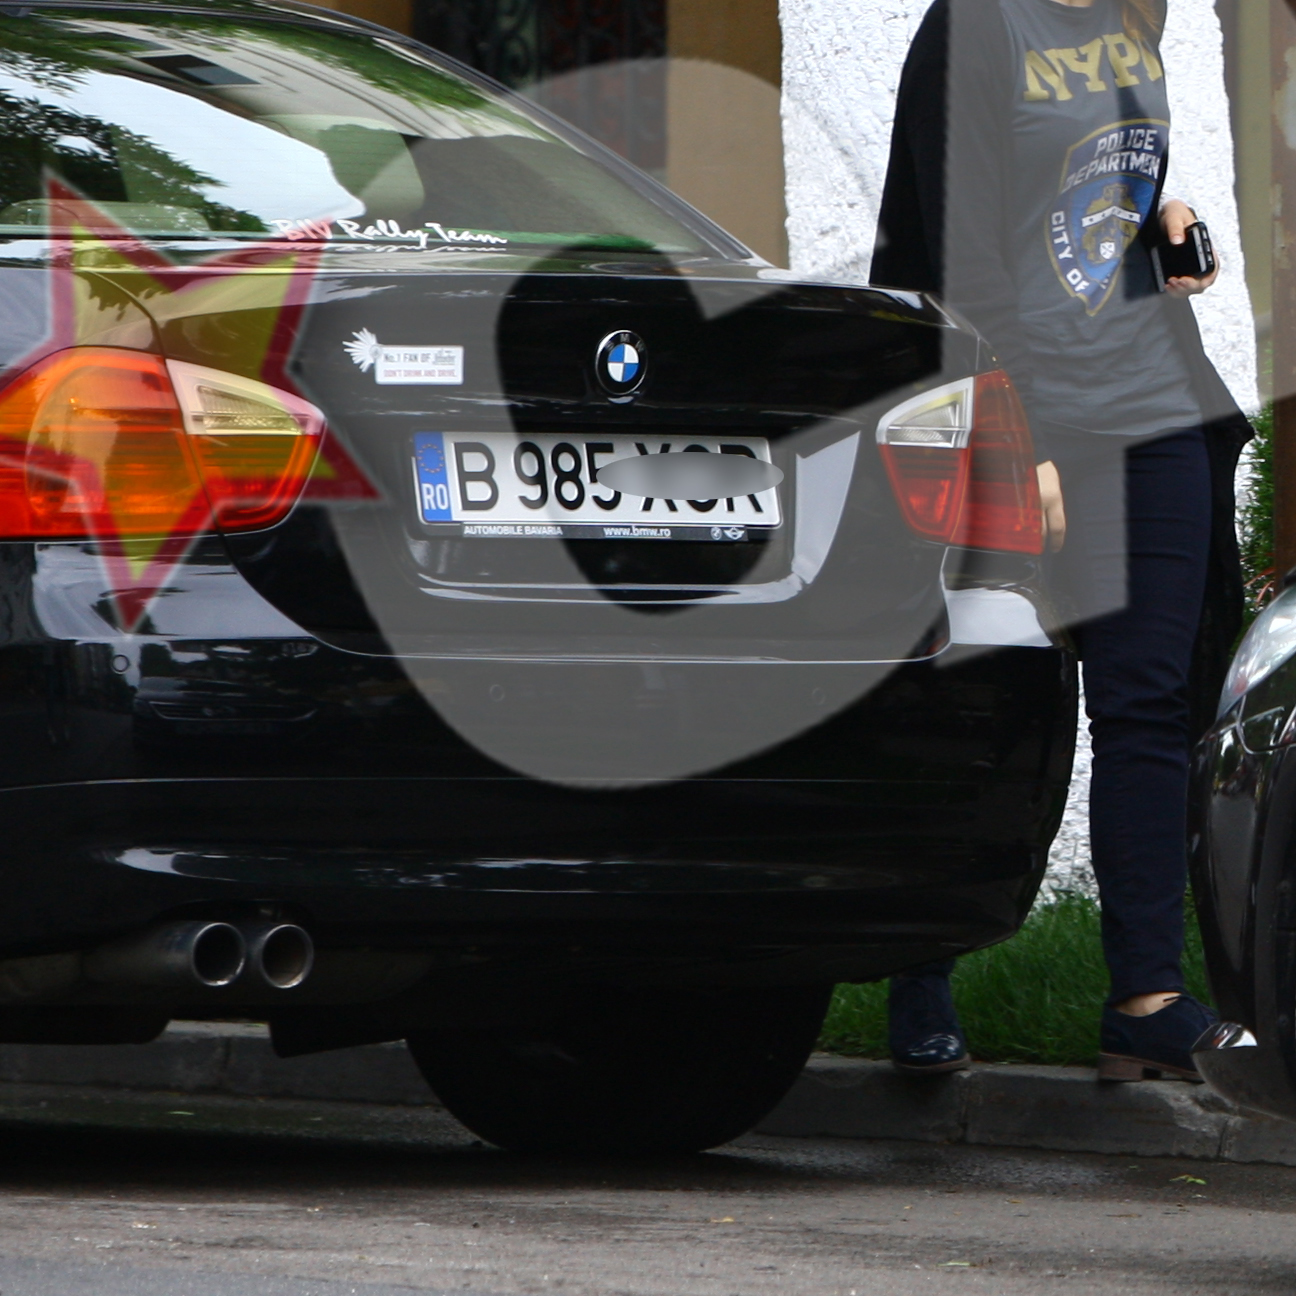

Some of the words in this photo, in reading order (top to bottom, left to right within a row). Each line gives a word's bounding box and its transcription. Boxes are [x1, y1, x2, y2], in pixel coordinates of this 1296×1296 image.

[1094, 129, 1158, 159] POLICE
[1061, 151, 1161, 194] DEPARTMEN
[336, 218, 429, 250] Rally
[424, 221, 508, 244] Team
[1051, 210, 1074, 260] CITY
[1066, 267, 1090, 292] OF
[452, 441, 500, 512] B
[512, 441, 623, 512] 985
[423, 483, 448, 510] RO
[463, 525, 523, 536] AUTOMOBILE
[524, 526, 564, 537] BAVARIA
[603, 525, 672, 538] www.bmw.ro
